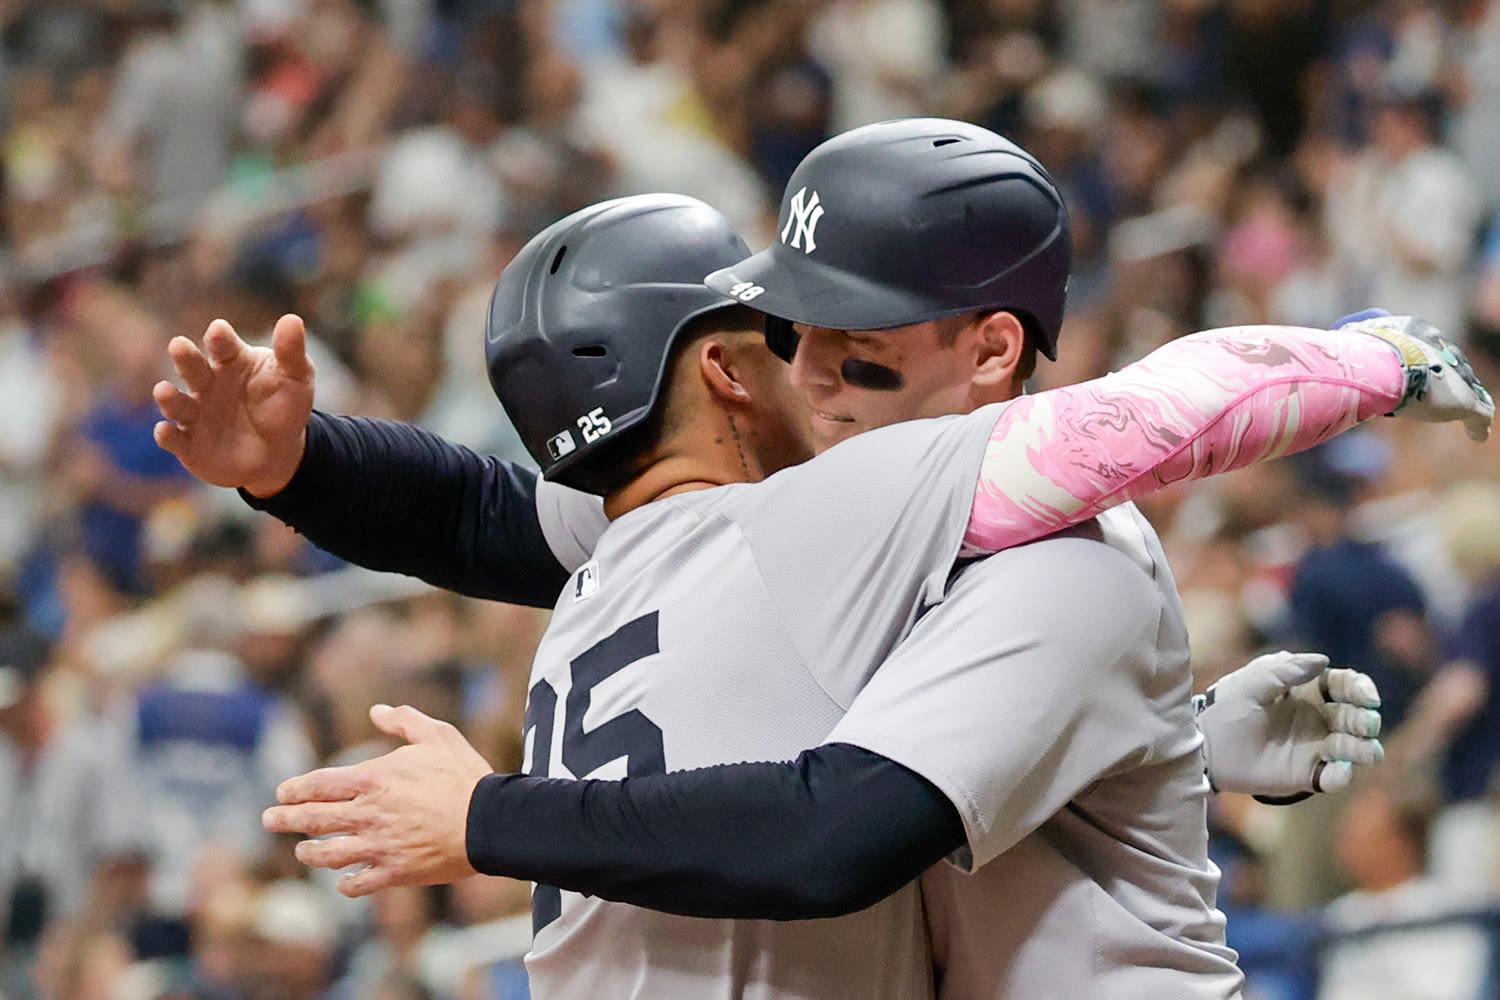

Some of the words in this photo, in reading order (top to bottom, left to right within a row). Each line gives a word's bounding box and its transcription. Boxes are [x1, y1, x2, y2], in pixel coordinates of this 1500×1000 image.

[781, 186, 825, 255] NY
[729, 281, 765, 301] 48
[576, 406, 612, 444] 25
